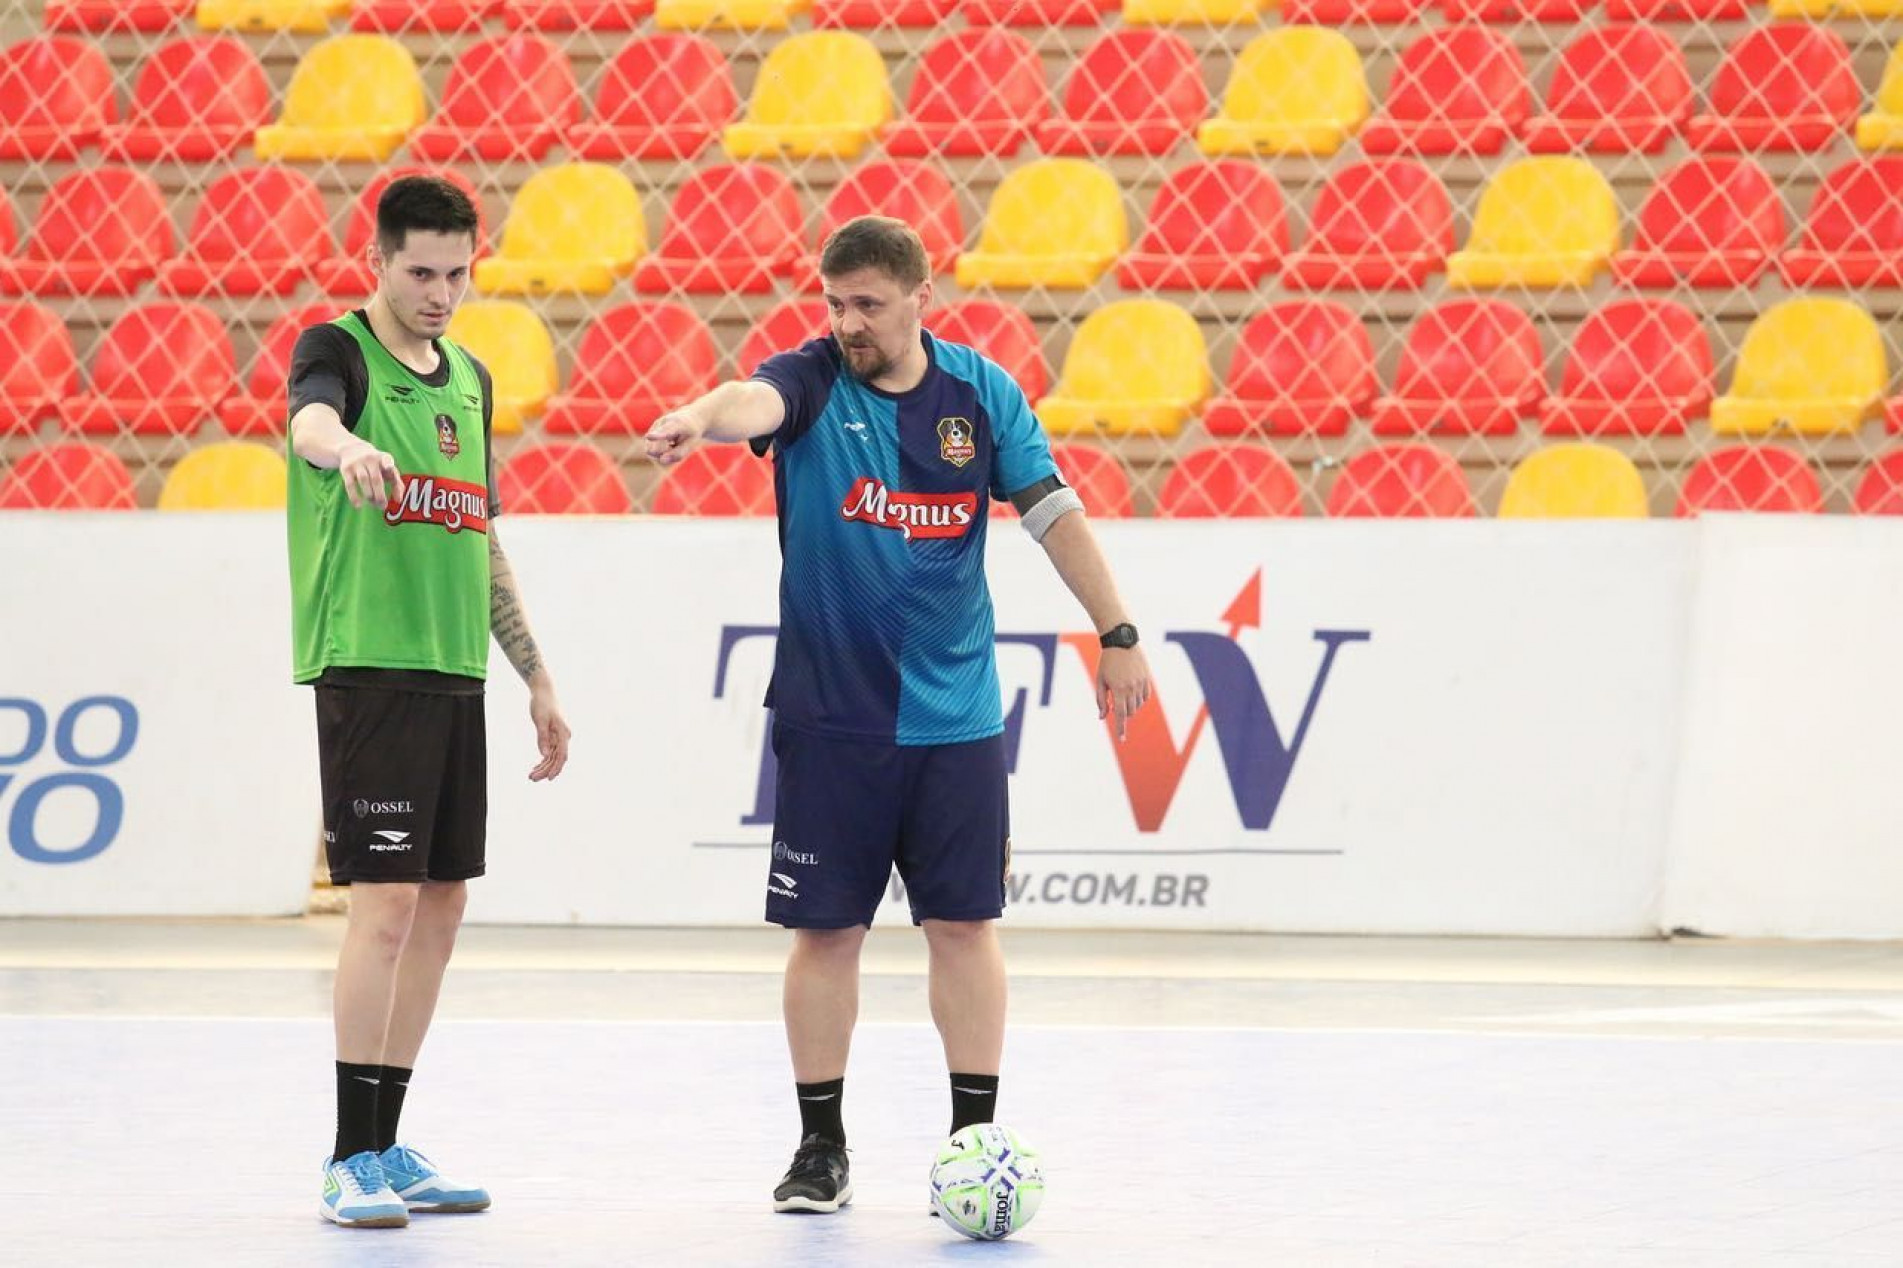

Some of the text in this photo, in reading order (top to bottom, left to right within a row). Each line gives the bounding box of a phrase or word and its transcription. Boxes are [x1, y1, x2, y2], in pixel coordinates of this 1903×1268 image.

[386, 477, 485, 530] Magnus
[842, 482, 971, 539] Mgnus
[0, 772, 124, 865] O
[370, 800, 414, 814] OSSEL
[369, 843, 413, 852] PENALTY
[994, 1191, 1010, 1233] Joma
